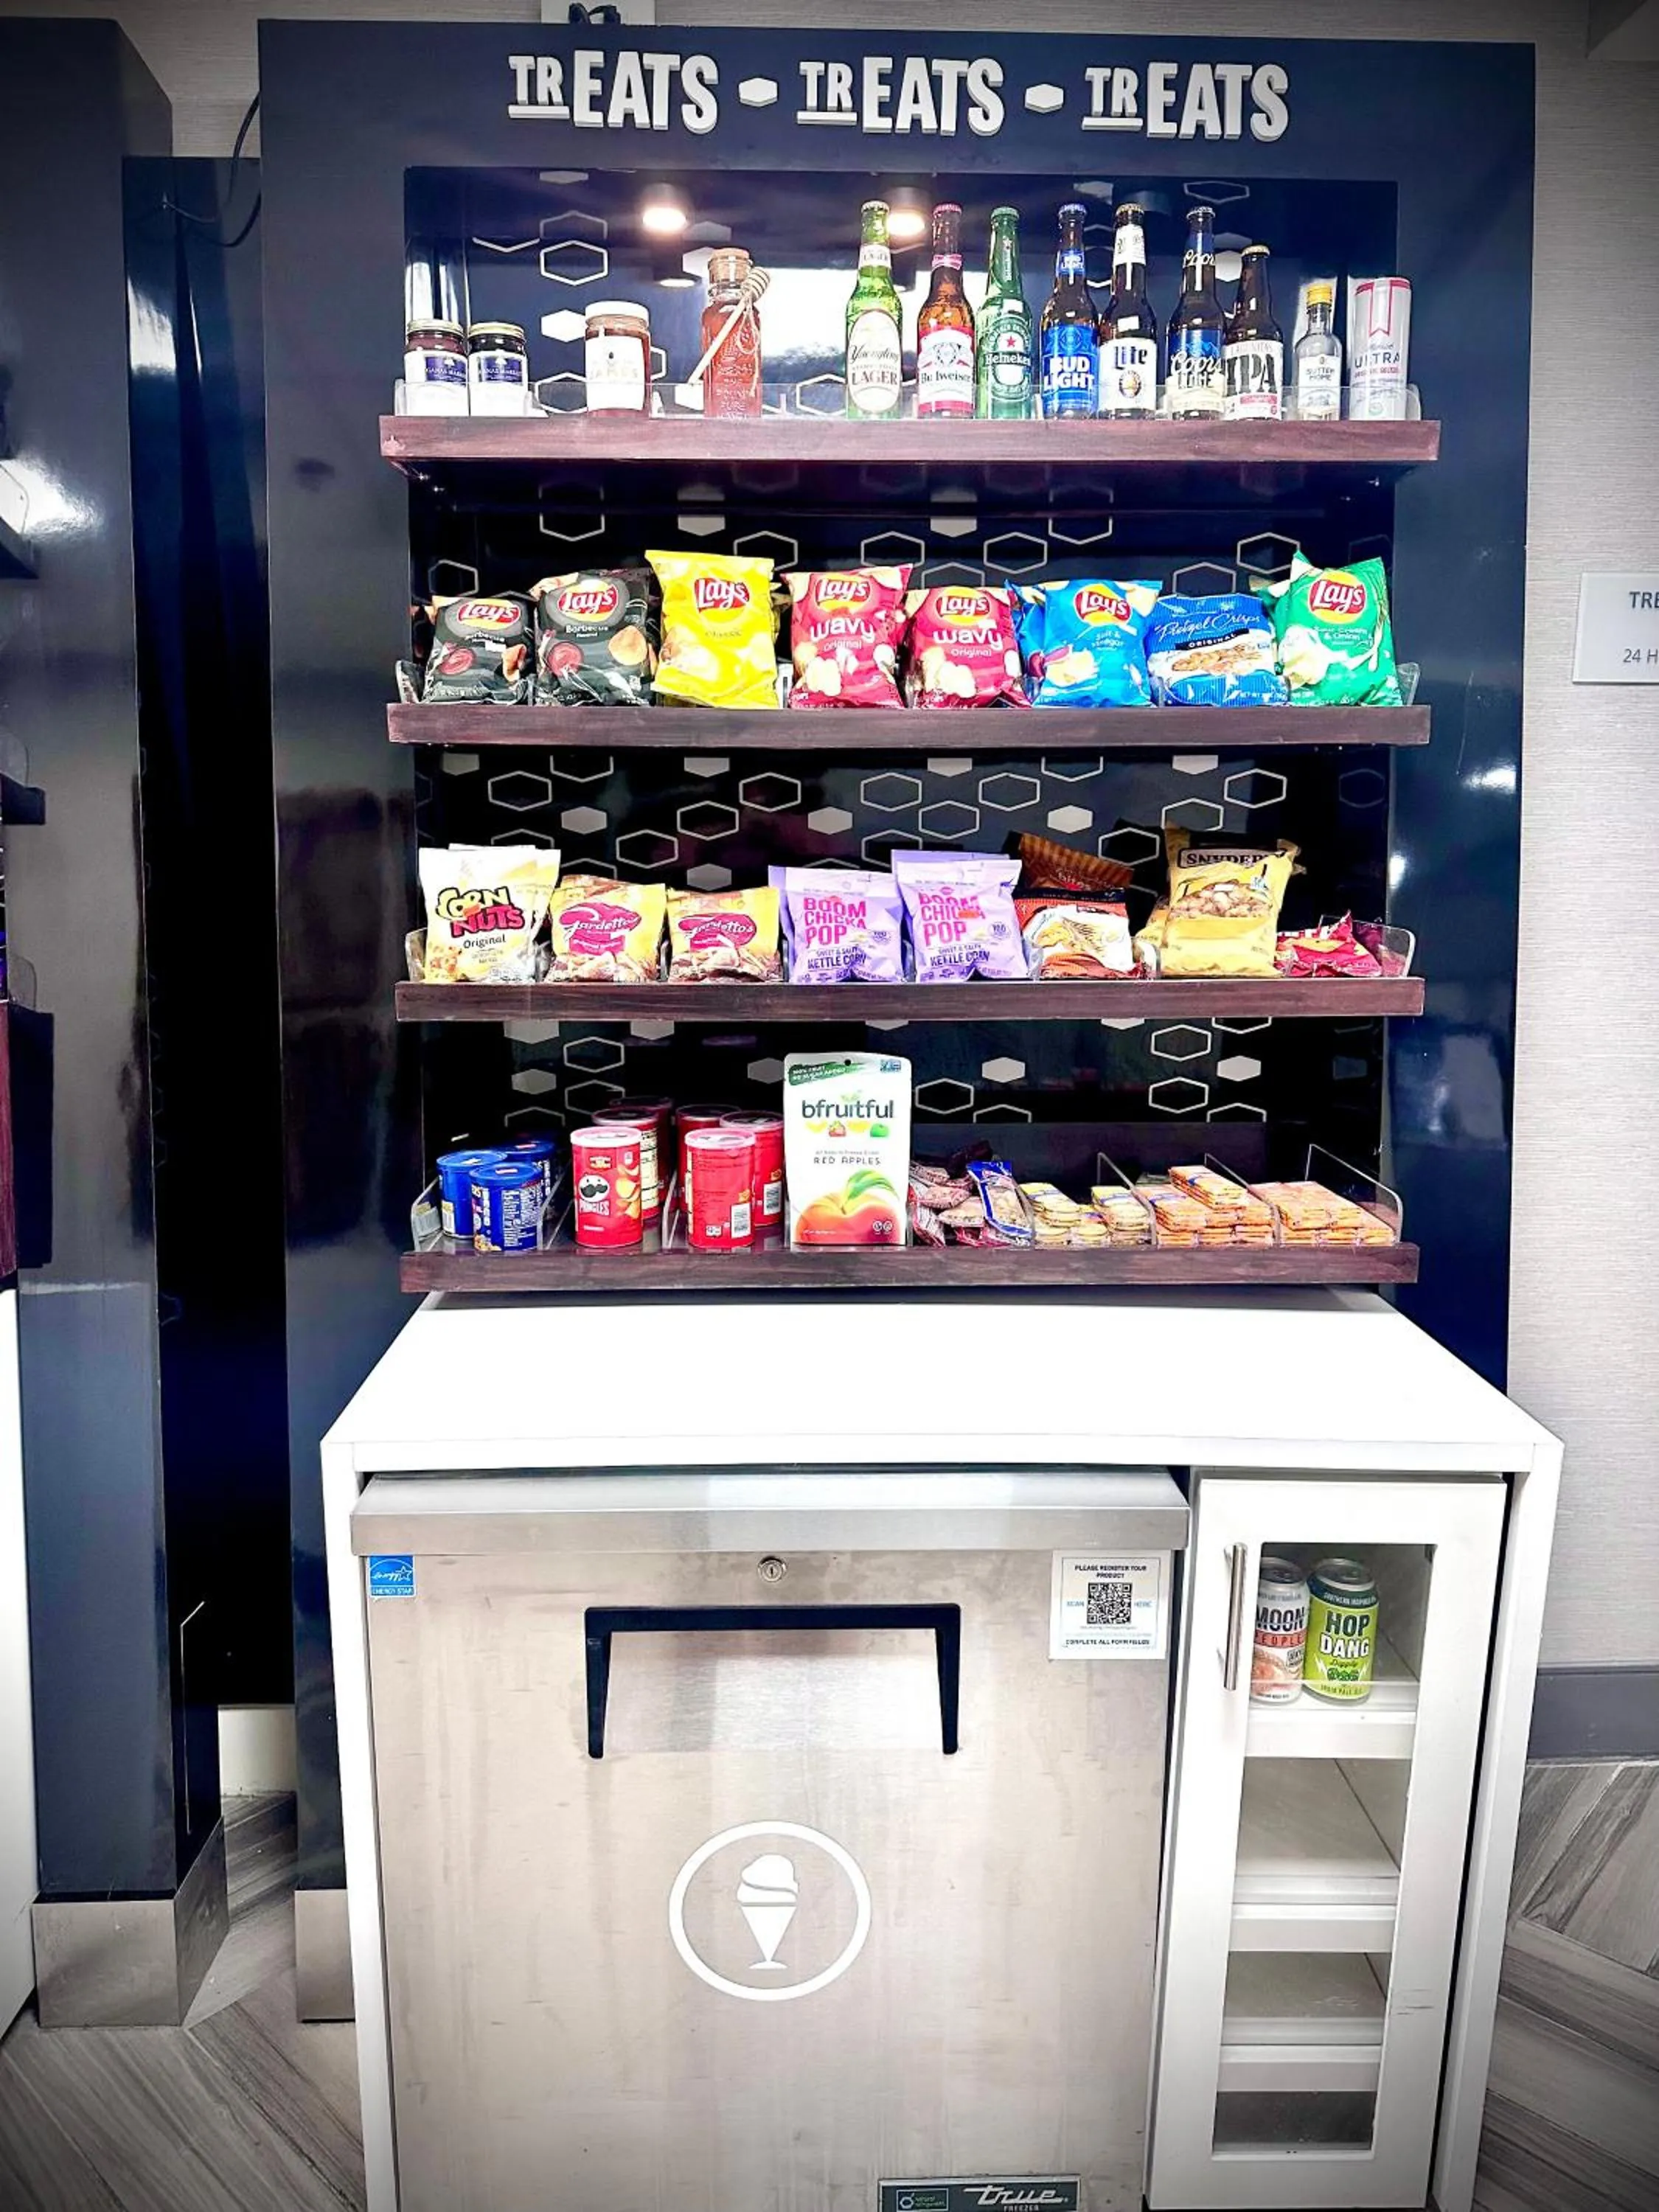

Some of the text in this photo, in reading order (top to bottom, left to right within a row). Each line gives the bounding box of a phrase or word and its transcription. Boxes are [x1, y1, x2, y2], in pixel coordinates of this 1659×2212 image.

[508, 49, 1290, 140] TREATS TREATS TREATS
[1049, 356, 1091, 373] BUD
[1113, 344, 1148, 369] Lite
[1354, 351, 1401, 369] ULTRA
[851, 370, 898, 386] LAGER
[1043, 372, 1095, 390] LIGHT
[1226, 353, 1278, 397] IPA
[810, 617, 876, 644] wavy
[933, 627, 1004, 650] wavy
[1188, 633, 1237, 648] ORIGINAL
[1623, 648, 1642, 663] 24
[803, 897, 867, 918] BOOM
[450, 904, 526, 939] NUTS
[804, 911, 868, 930] CHICKA
[462, 933, 507, 949] Original
[804, 925, 847, 949] POP
[922, 921, 967, 947] POP
[807, 956, 841, 970] KETTLE
[930, 954, 965, 967] KETTLE
[801, 1099, 894, 1119] bfruitful
[841, 1155, 881, 1166] APPLES
[1325, 1610, 1371, 1637] HOP
[1320, 1632, 1370, 1660] DANG
[963, 2185, 1063, 2205] true
